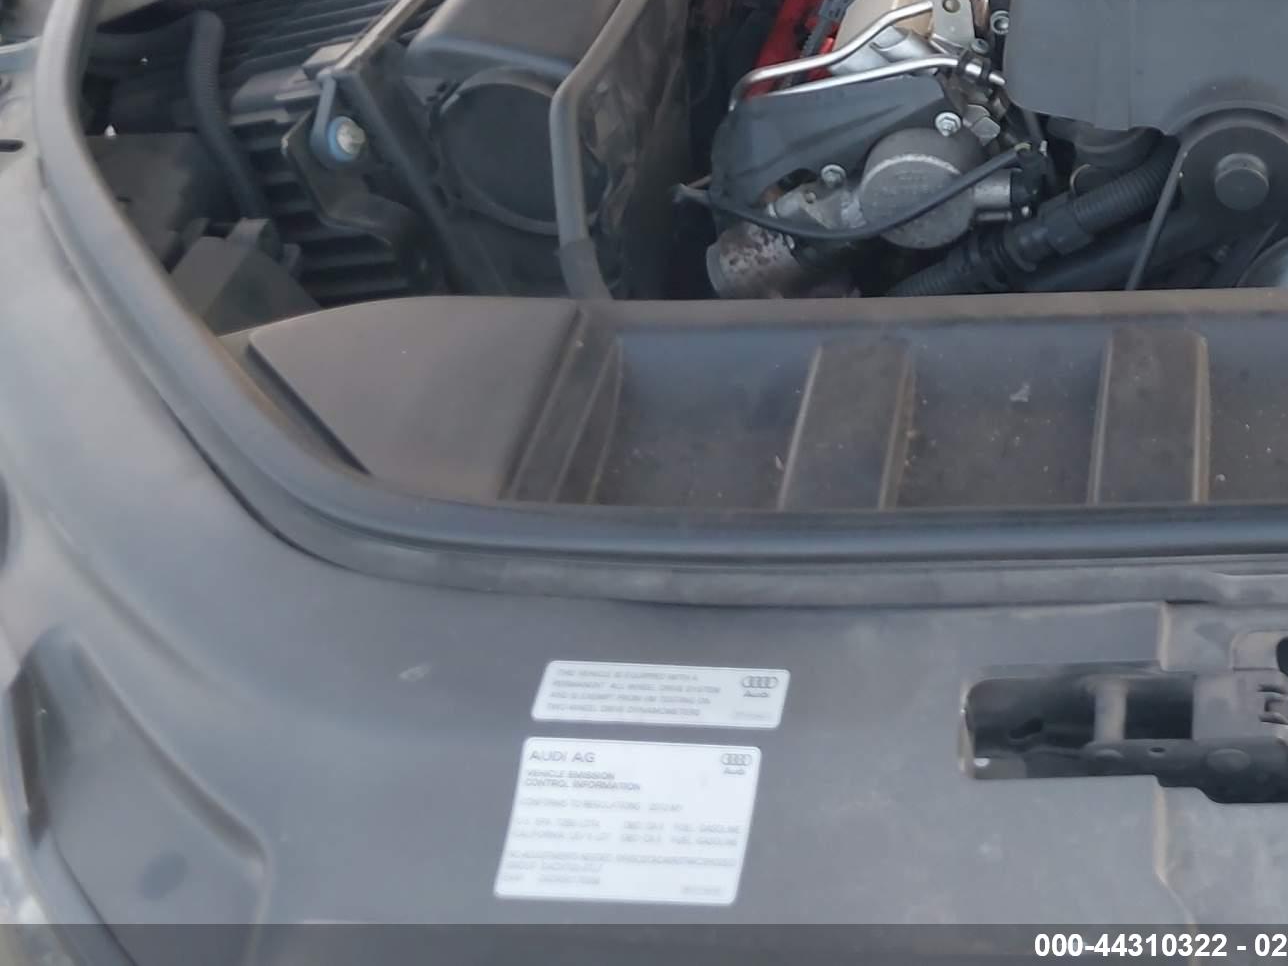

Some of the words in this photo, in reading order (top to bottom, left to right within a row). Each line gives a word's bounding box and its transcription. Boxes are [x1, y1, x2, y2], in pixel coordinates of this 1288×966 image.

[529, 750, 567, 762] AUDI
[571, 752, 597, 763] AG
[568, 771, 615, 780] EMISSION
[525, 778, 569, 788] CONTROL
[572, 780, 641, 791] INFORMATION
